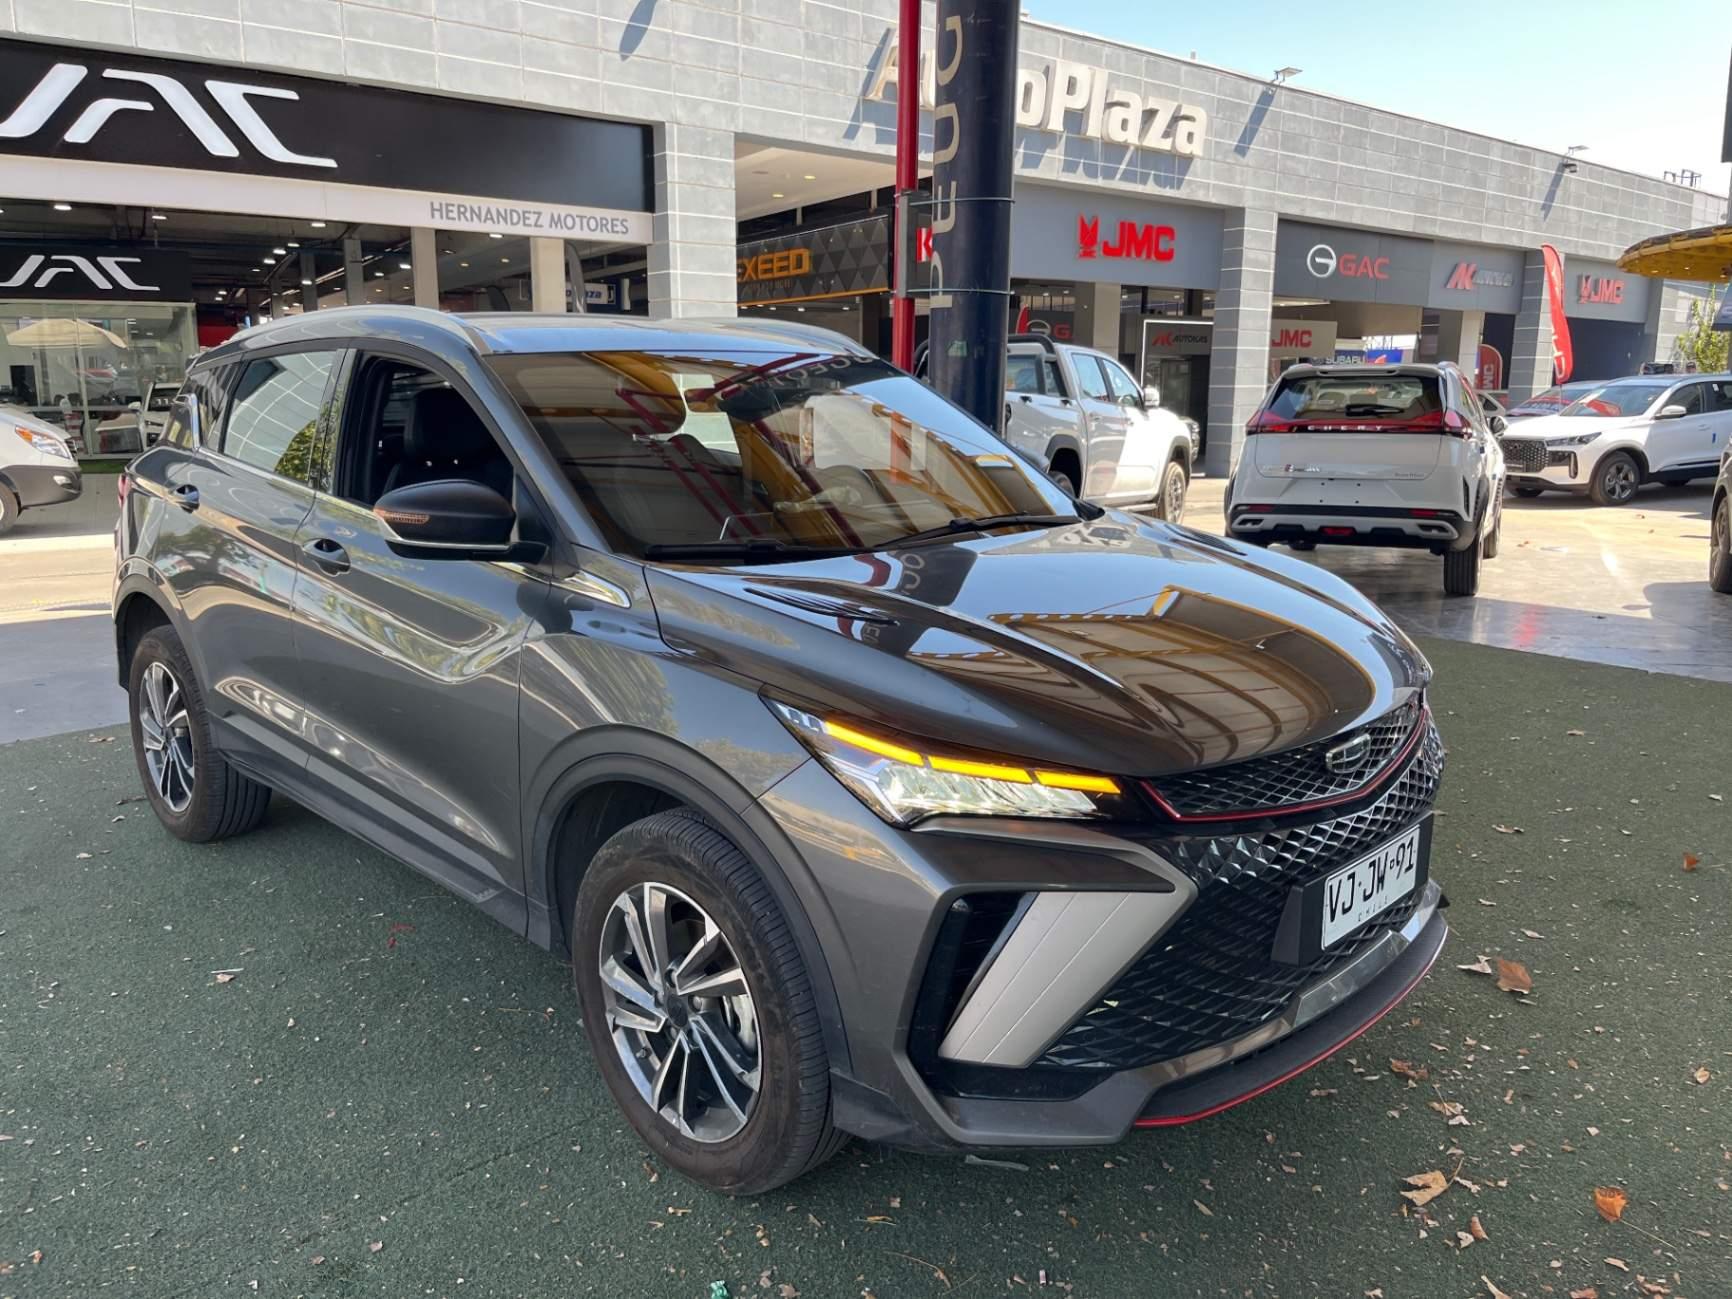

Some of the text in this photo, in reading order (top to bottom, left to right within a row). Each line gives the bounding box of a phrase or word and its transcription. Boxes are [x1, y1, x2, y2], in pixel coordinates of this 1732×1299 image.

[0, 63, 338, 168] JAC
[430, 201, 629, 235] HERNANDEZ MOTORES
[1102, 220, 1176, 262] JMC
[0, 254, 161, 291] JAC
[1338, 252, 1390, 280] GAC
[1592, 277, 1625, 304] JMC
[1271, 329, 1313, 348] JMC
